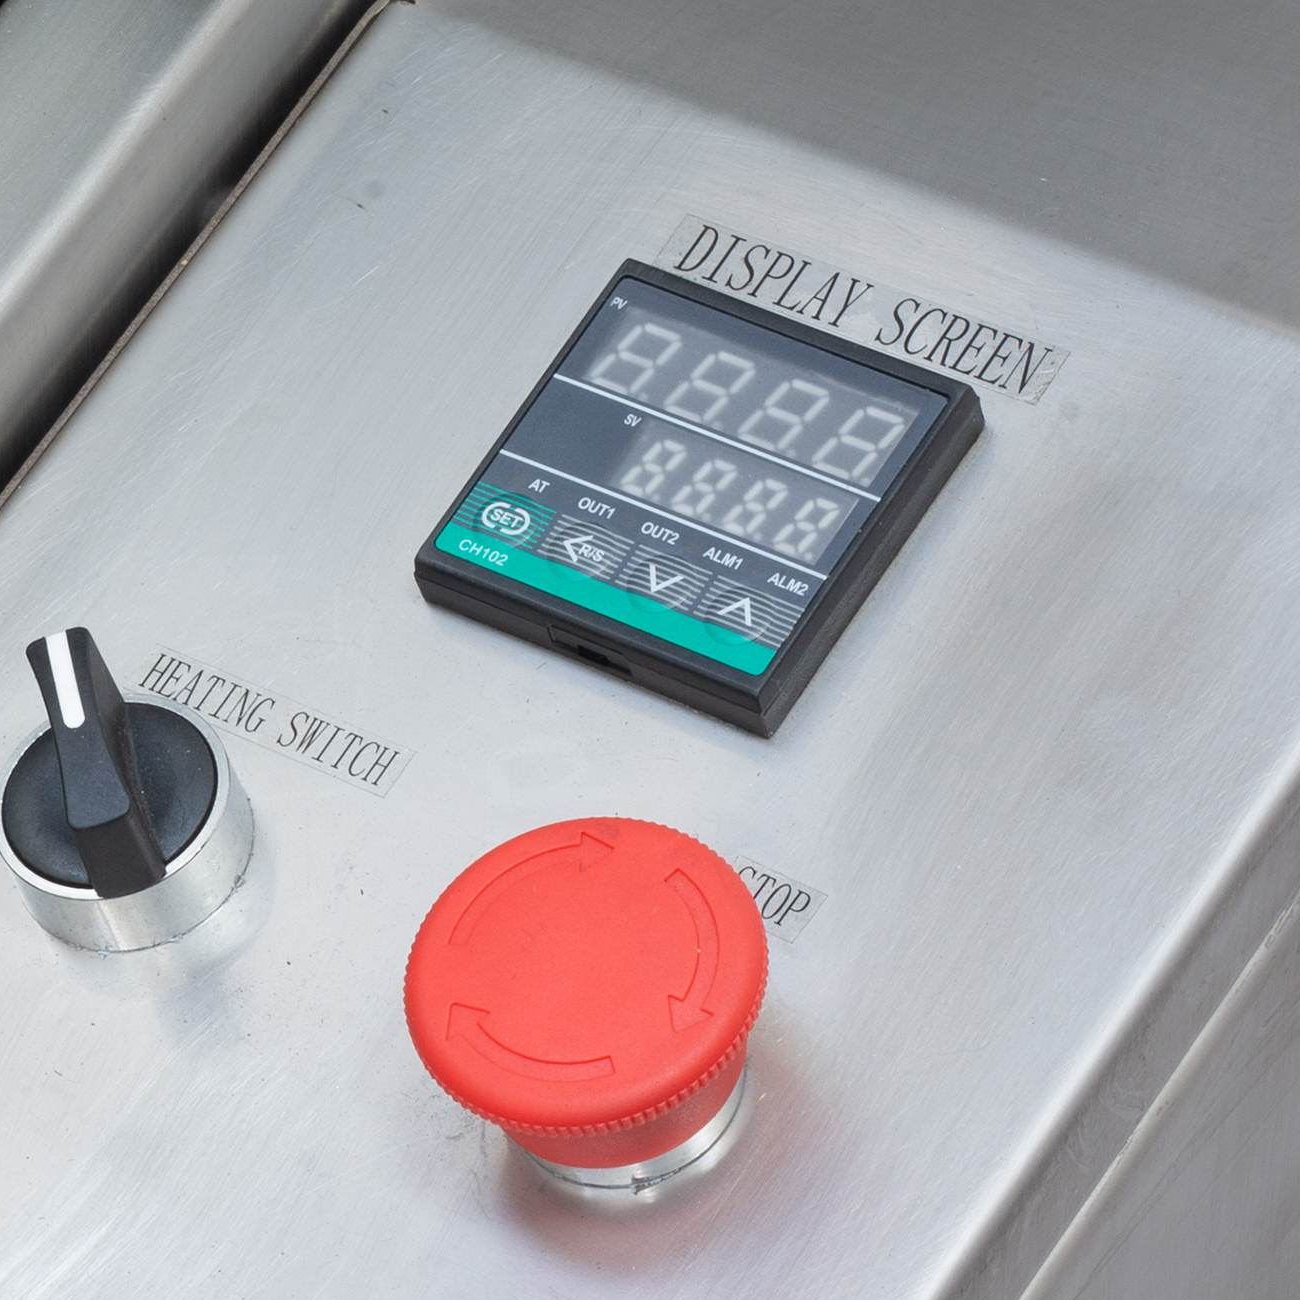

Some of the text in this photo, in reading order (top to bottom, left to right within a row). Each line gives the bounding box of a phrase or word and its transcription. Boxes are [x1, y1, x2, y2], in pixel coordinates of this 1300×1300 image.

[610, 296, 628, 310] PV
[673, 224, 1053, 394] DISPLAY SCREEN
[623, 414, 642, 427] SV
[528, 479, 550, 493] AT
[490, 508, 523, 528] SET
[578, 497, 616, 519] OUT1
[641, 521, 680, 545] OUT2
[458, 539, 508, 566] CH102
[578, 544, 605, 563] R/S
[703, 547, 743, 570] ALM1
[767, 572, 809, 597] ALM2
[138, 654, 400, 786] HEATING SWITCH
